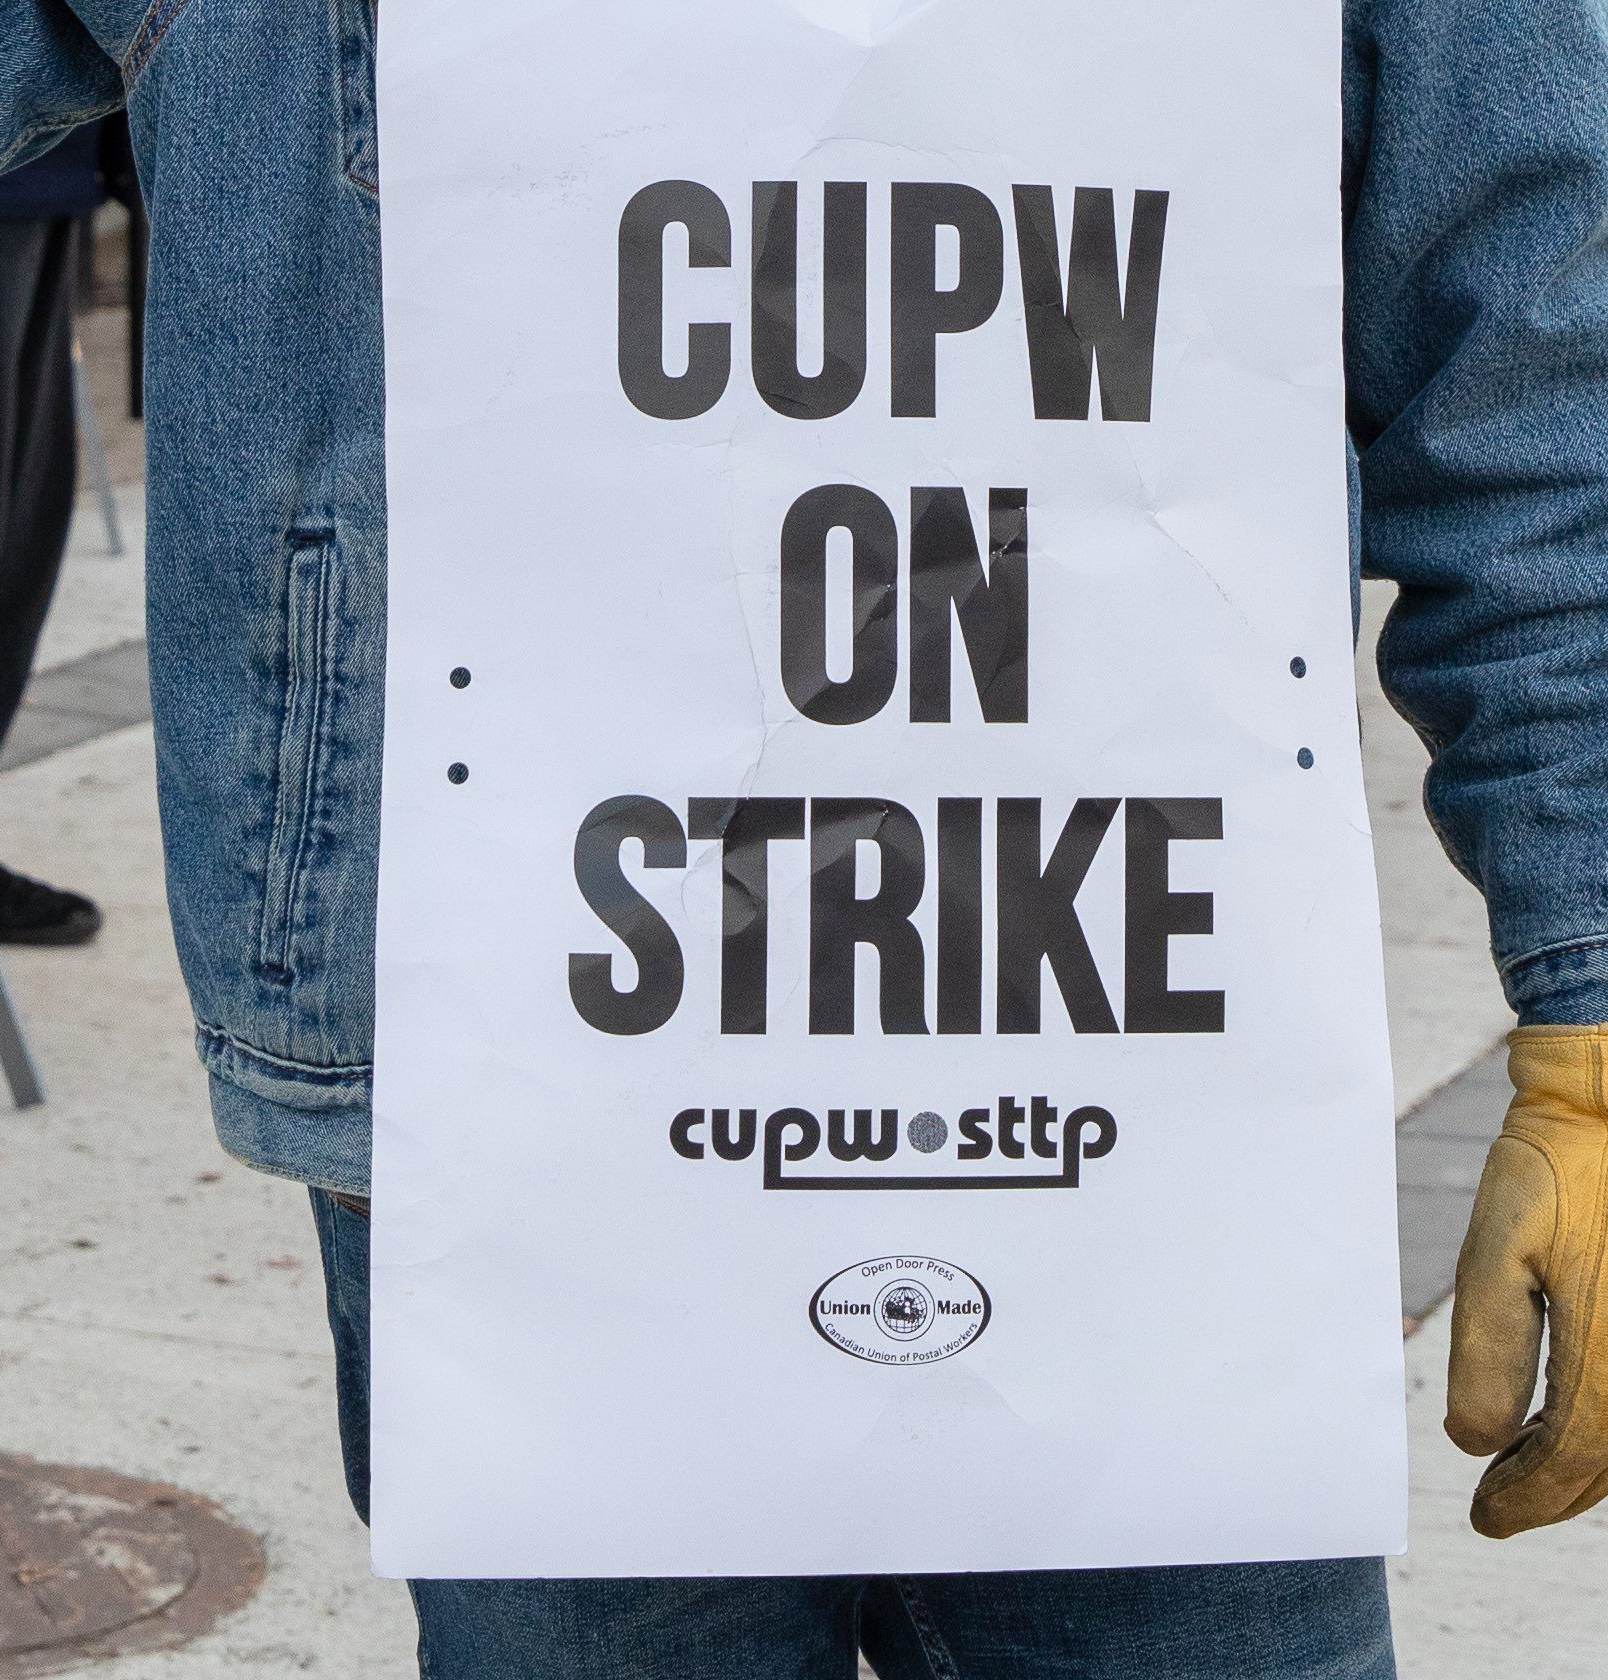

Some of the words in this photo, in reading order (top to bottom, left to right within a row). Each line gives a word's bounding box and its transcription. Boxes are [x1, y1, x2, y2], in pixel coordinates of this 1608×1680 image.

[617, 178, 1170, 423] CUPW
[780, 483, 1029, 726] ON
[568, 794, 1226, 1036] STRIKE
[861, 1261, 892, 1278] Open
[895, 1258, 924, 1269] Door
[926, 1260, 955, 1282] Press
[819, 1300, 871, 1315] Union
[937, 1300, 982, 1315] Made
[824, 1322, 865, 1355] Canadian
[867, 1348, 897, 1362] Union
[899, 1351, 910, 1362] of
[912, 1345, 943, 1362] Postal
[943, 1322, 978, 1353] Workers
